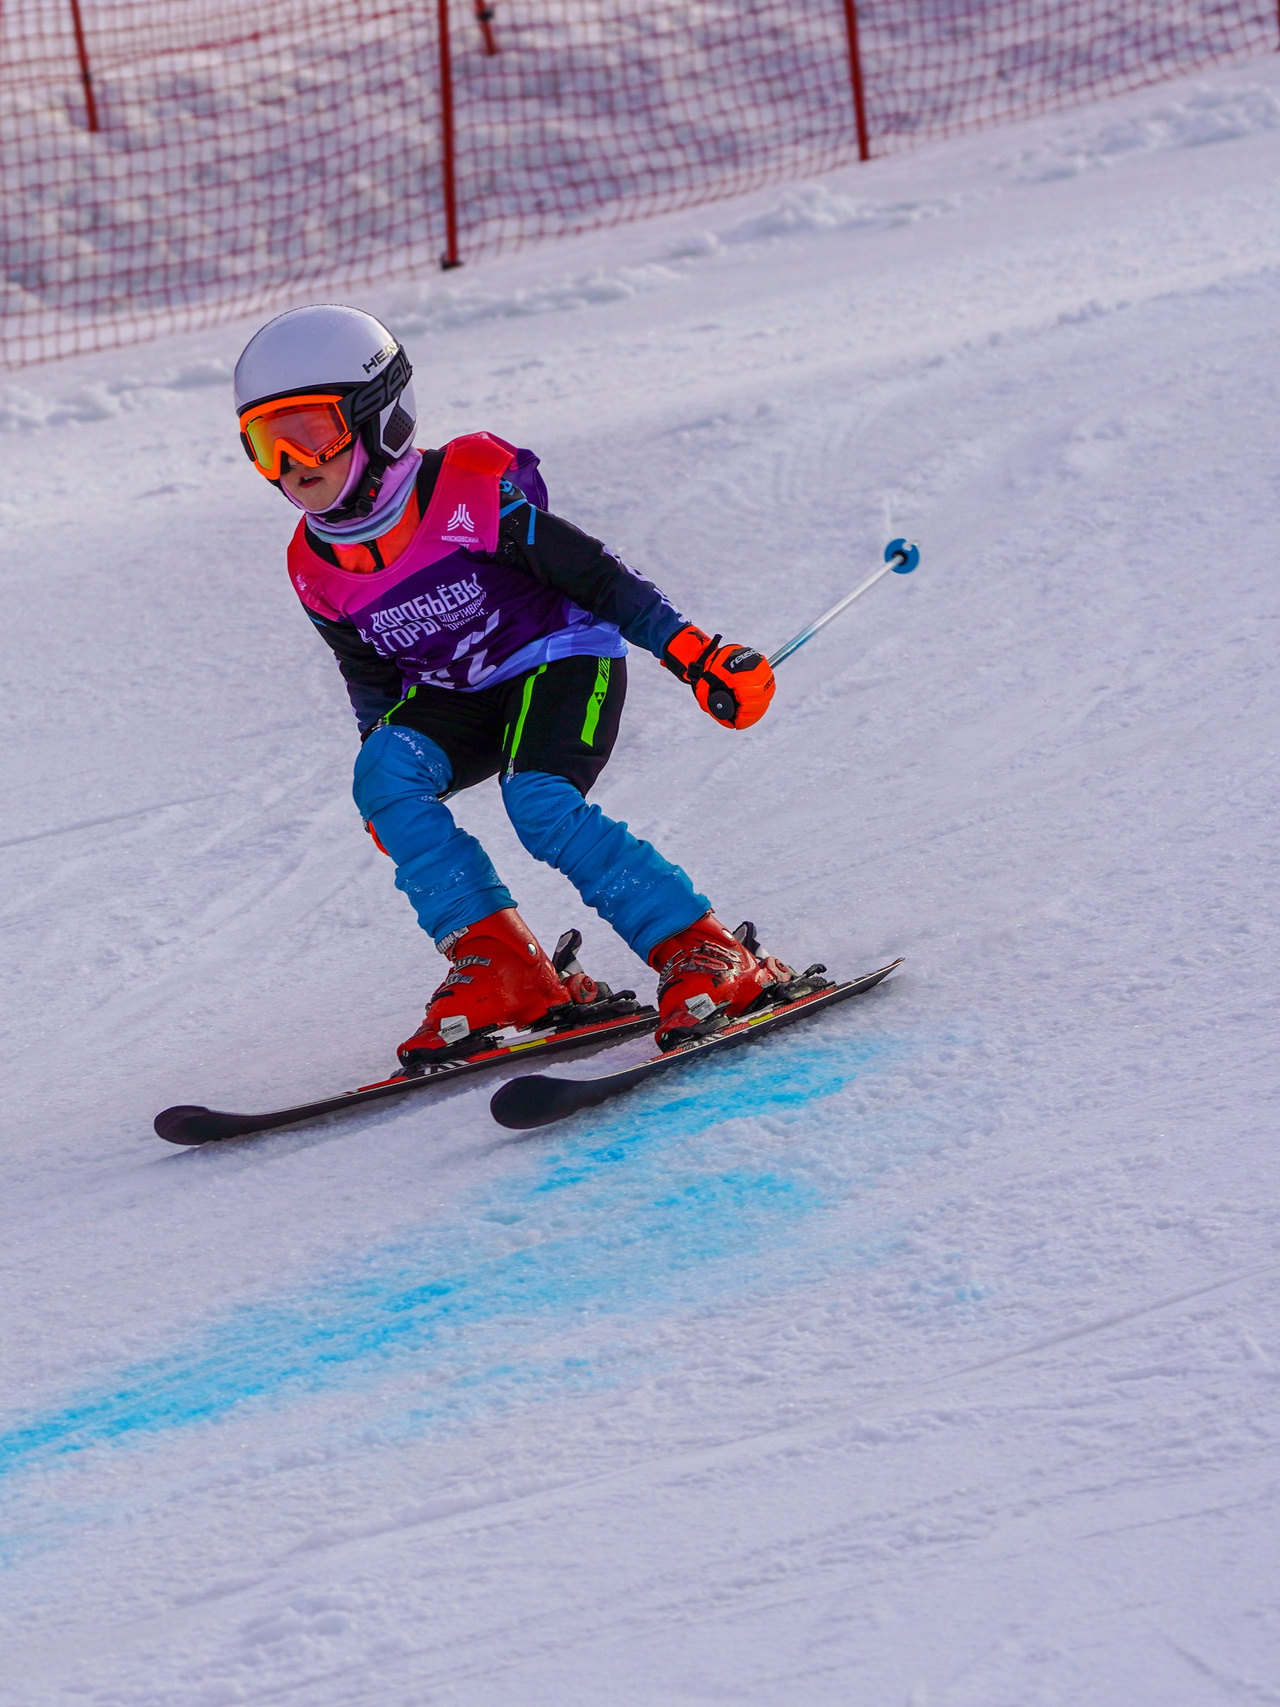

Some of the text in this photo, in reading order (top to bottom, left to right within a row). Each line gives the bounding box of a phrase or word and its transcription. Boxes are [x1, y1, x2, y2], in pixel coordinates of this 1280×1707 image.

[325, 431, 352, 461] RACE
[370, 572, 483, 633] ВОРОБЬЁВЫ
[381, 617, 441, 652] ГОРЫ
[441, 1022, 463, 1035] ATOMIC
